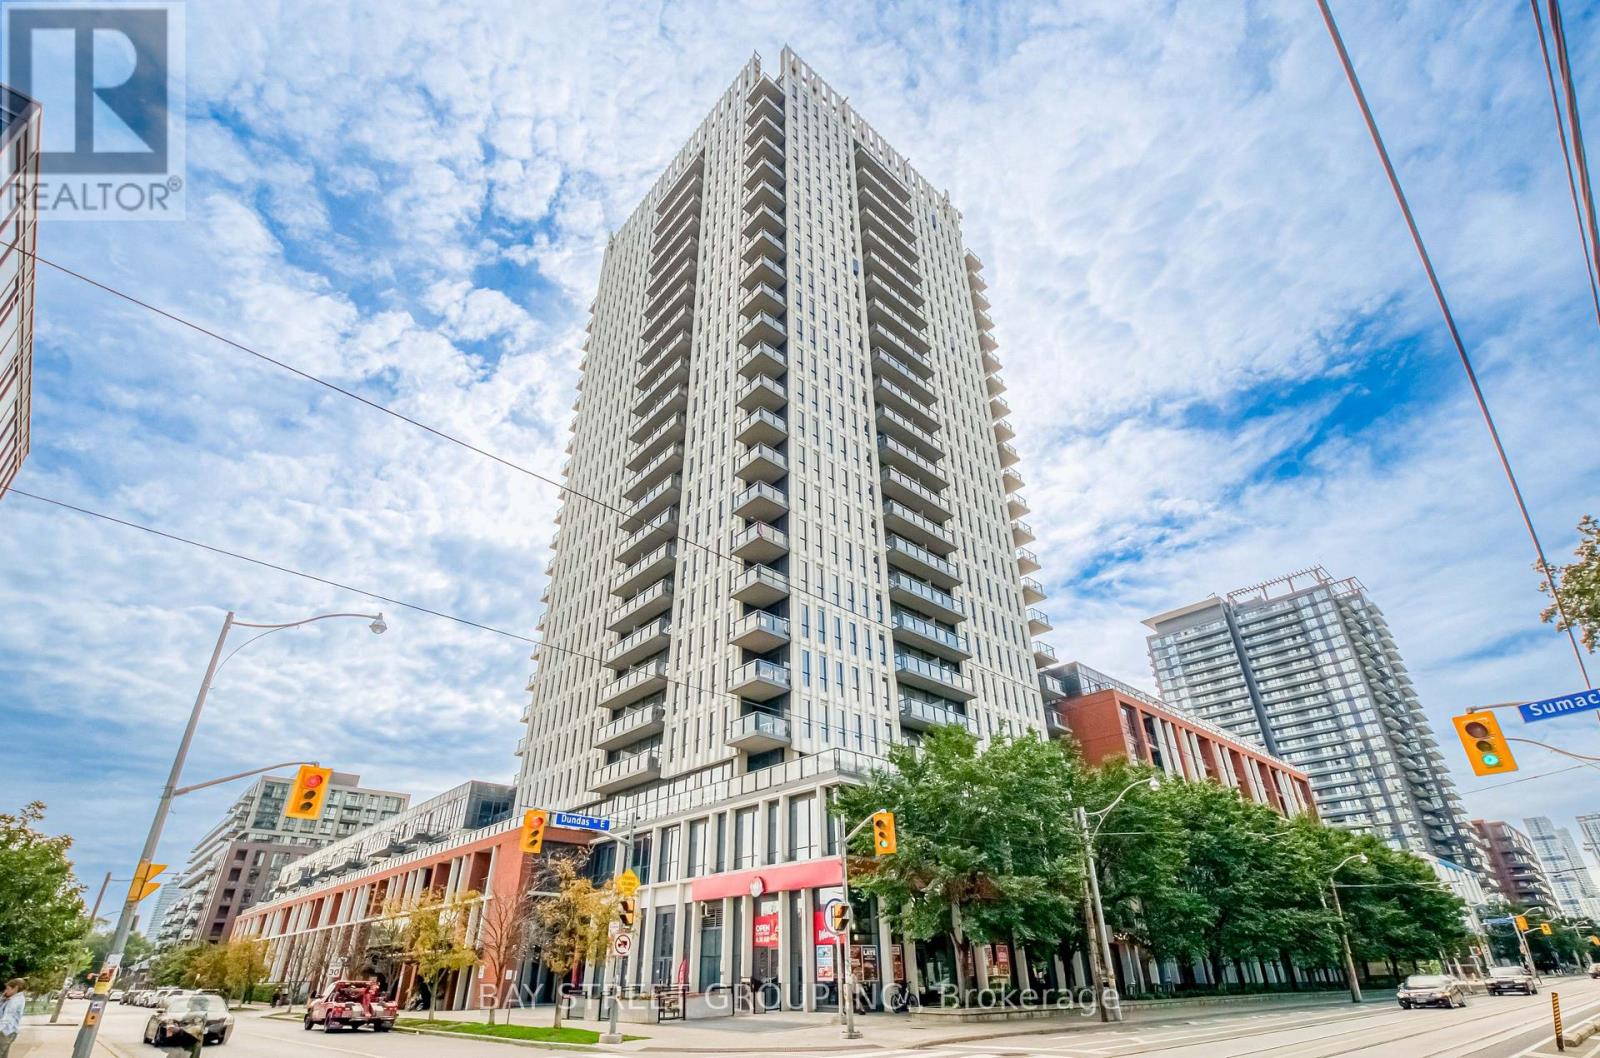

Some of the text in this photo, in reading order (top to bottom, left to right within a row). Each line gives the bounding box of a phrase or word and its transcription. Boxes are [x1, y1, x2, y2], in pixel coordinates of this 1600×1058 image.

[1529, 693, 1600, 716] Sumac
[561, 814, 590, 826] Dundas
[600, 820, 606, 828] E
[328, 968, 339, 976] 30
